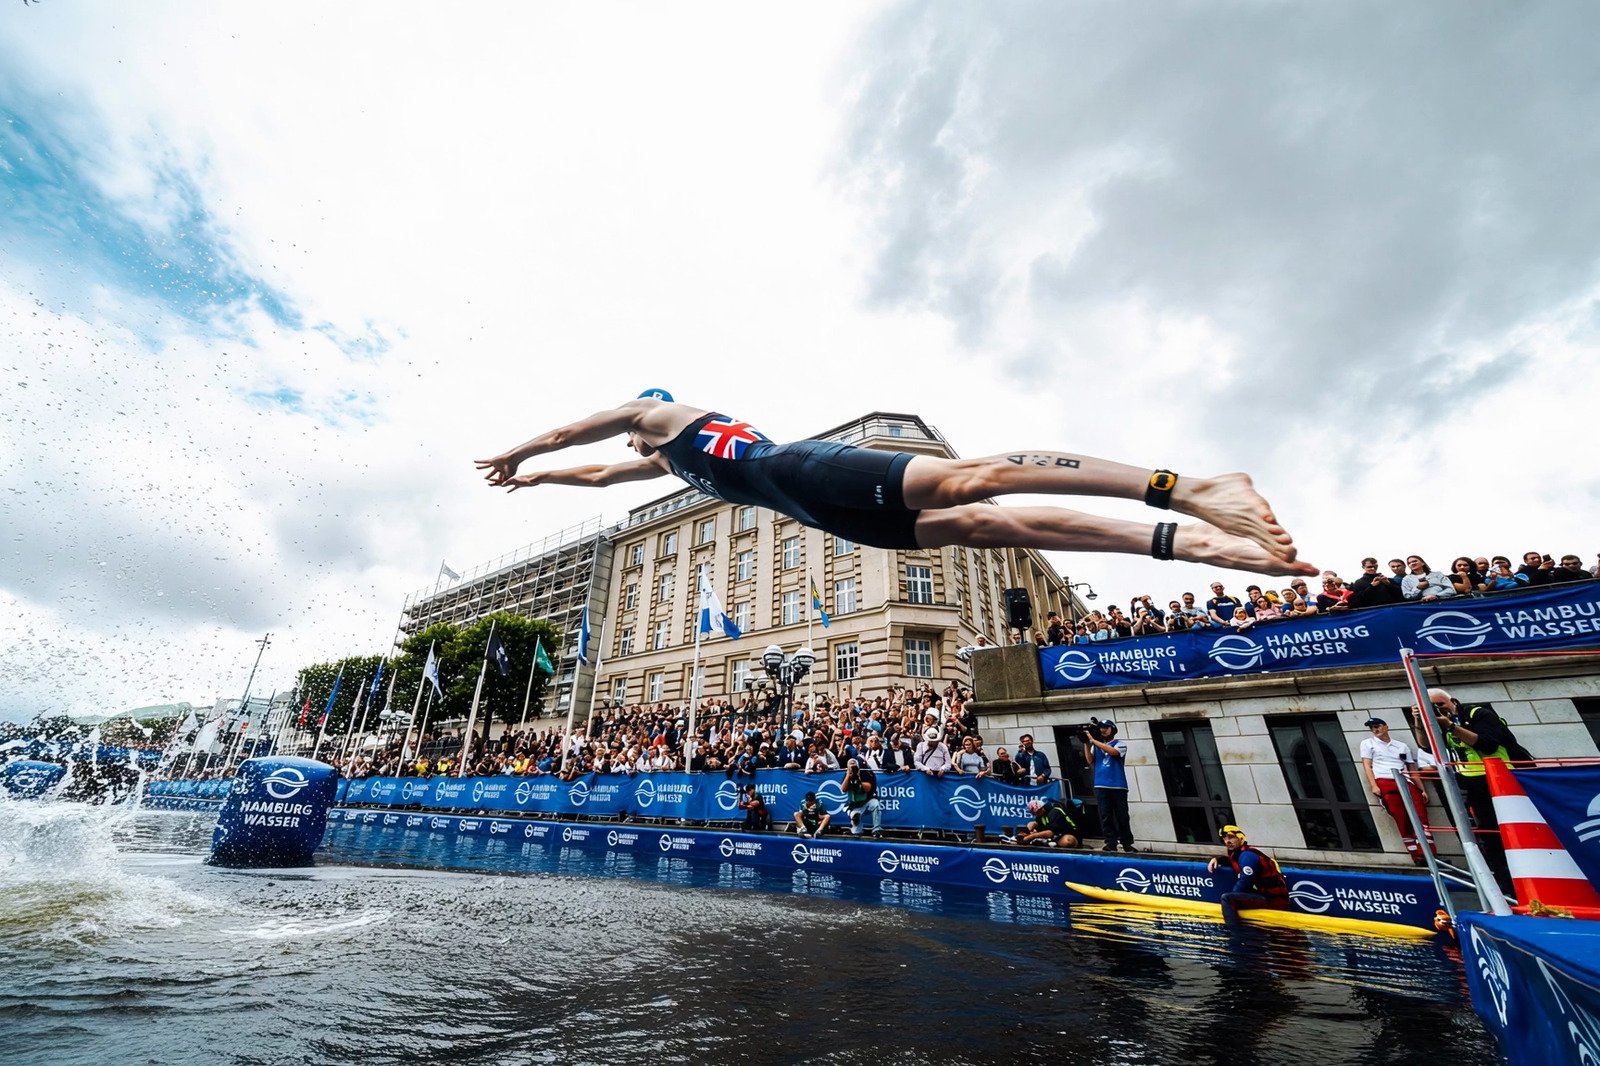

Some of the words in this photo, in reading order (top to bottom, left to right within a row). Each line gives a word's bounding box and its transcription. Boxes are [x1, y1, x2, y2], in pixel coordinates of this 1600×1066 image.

[1494, 601, 1600, 624] HAMBU
[1265, 625, 1370, 647] HAMBURG
[1098, 646, 1176, 663] HAMBURG
[1270, 642, 1349, 659] WASSER
[1101, 660, 1160, 674] WASSER
[240, 801, 313, 815] HAMBURG
[244, 813, 300, 828] WASSER
[1011, 862, 1060, 875] HAMBURG
[1012, 871, 1049, 883] WASSER
[1152, 873, 1214, 888] HAMBURG
[1154, 884, 1202, 897] WASSER
[1335, 887, 1418, 905] HAMBURG
[1338, 899, 1402, 915] WASSER
